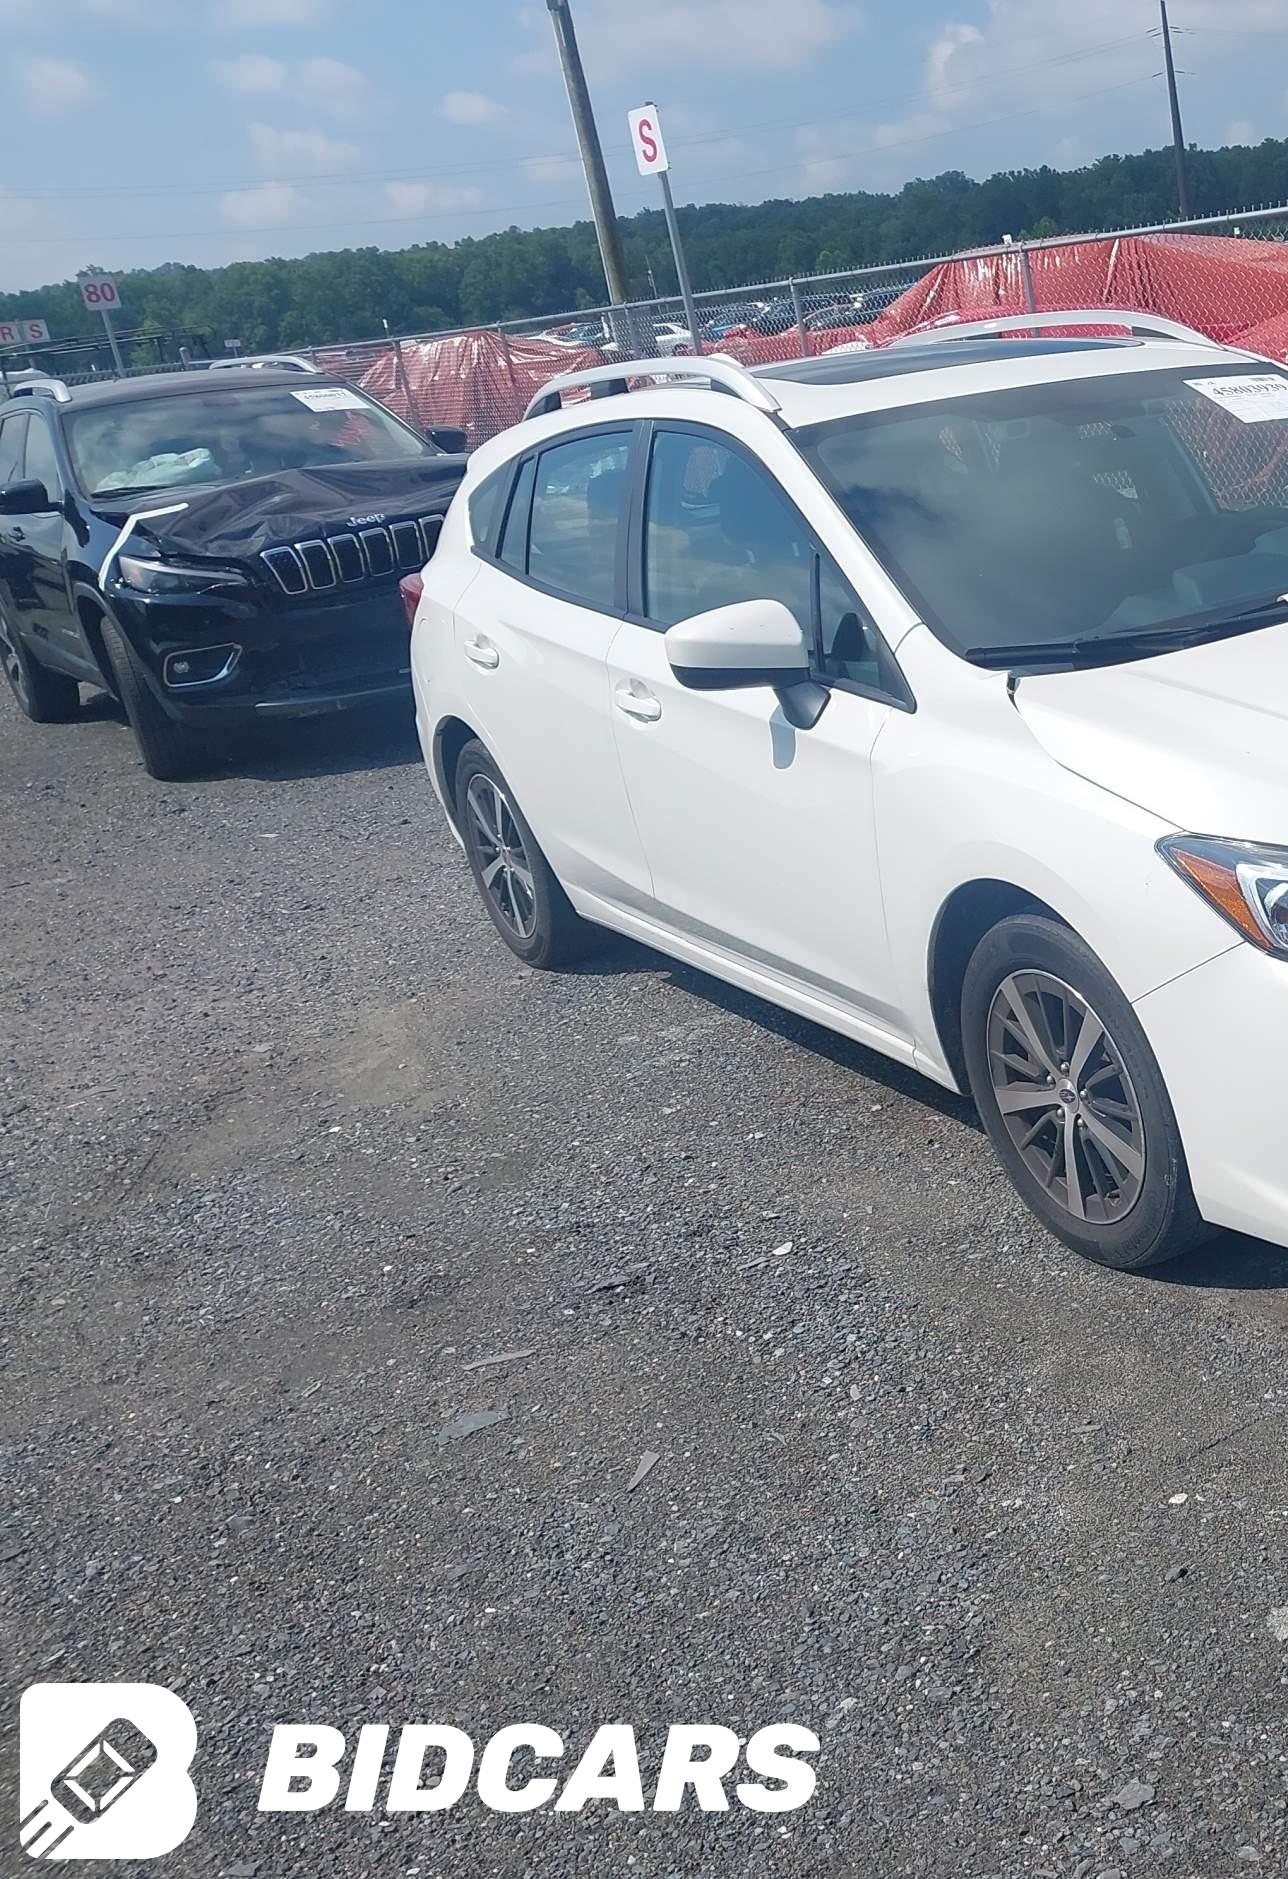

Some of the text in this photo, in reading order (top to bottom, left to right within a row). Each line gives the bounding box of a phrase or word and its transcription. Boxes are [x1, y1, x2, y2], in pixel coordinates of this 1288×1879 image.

[638, 118, 658, 163] S
[84, 282, 115, 303] 80
[0, 326, 14, 341] R
[30, 323, 43, 339] S
[346, 513, 385, 527] Jeep
